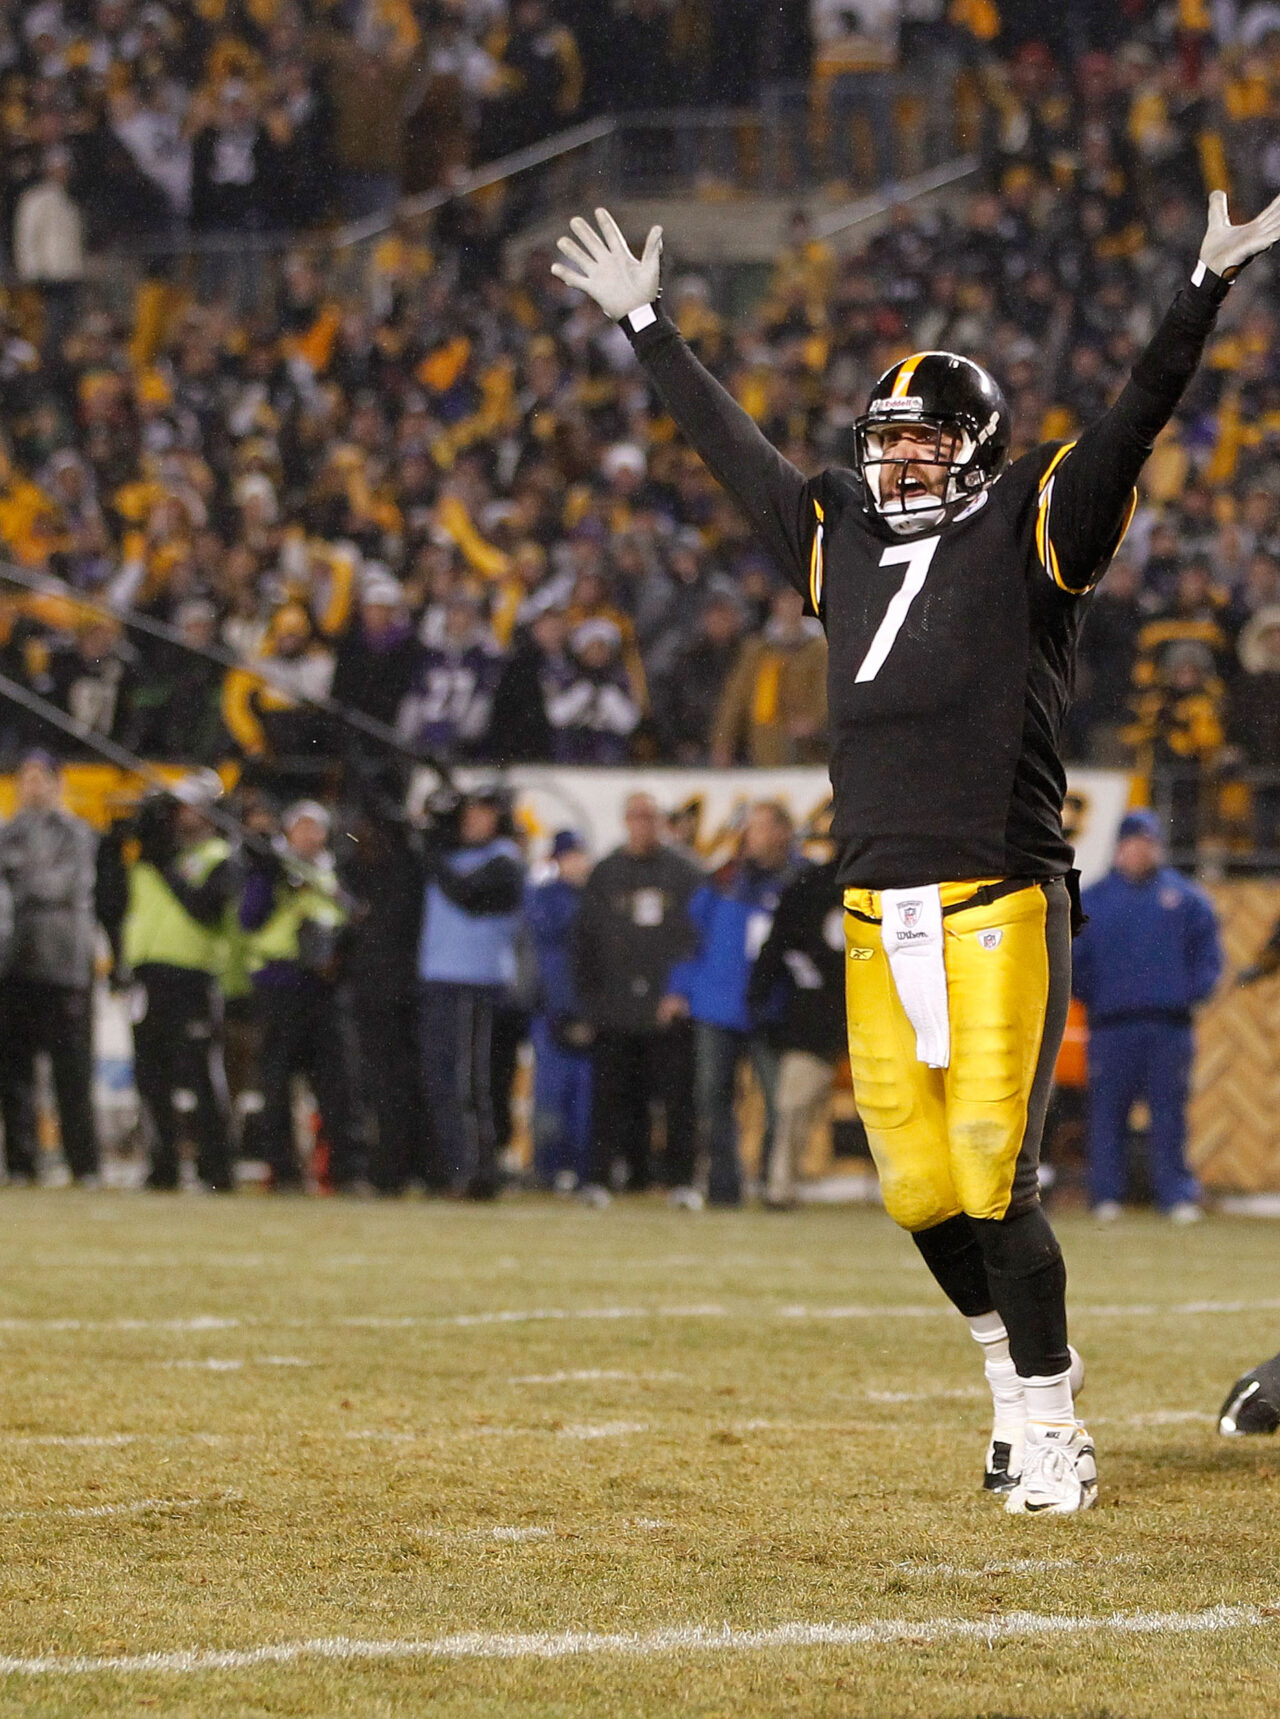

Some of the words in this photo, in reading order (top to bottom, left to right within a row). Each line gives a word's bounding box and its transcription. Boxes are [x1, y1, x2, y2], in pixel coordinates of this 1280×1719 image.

[891, 372, 914, 398] 7
[854, 535, 941, 683] 7
[896, 931, 928, 940] Wilson
